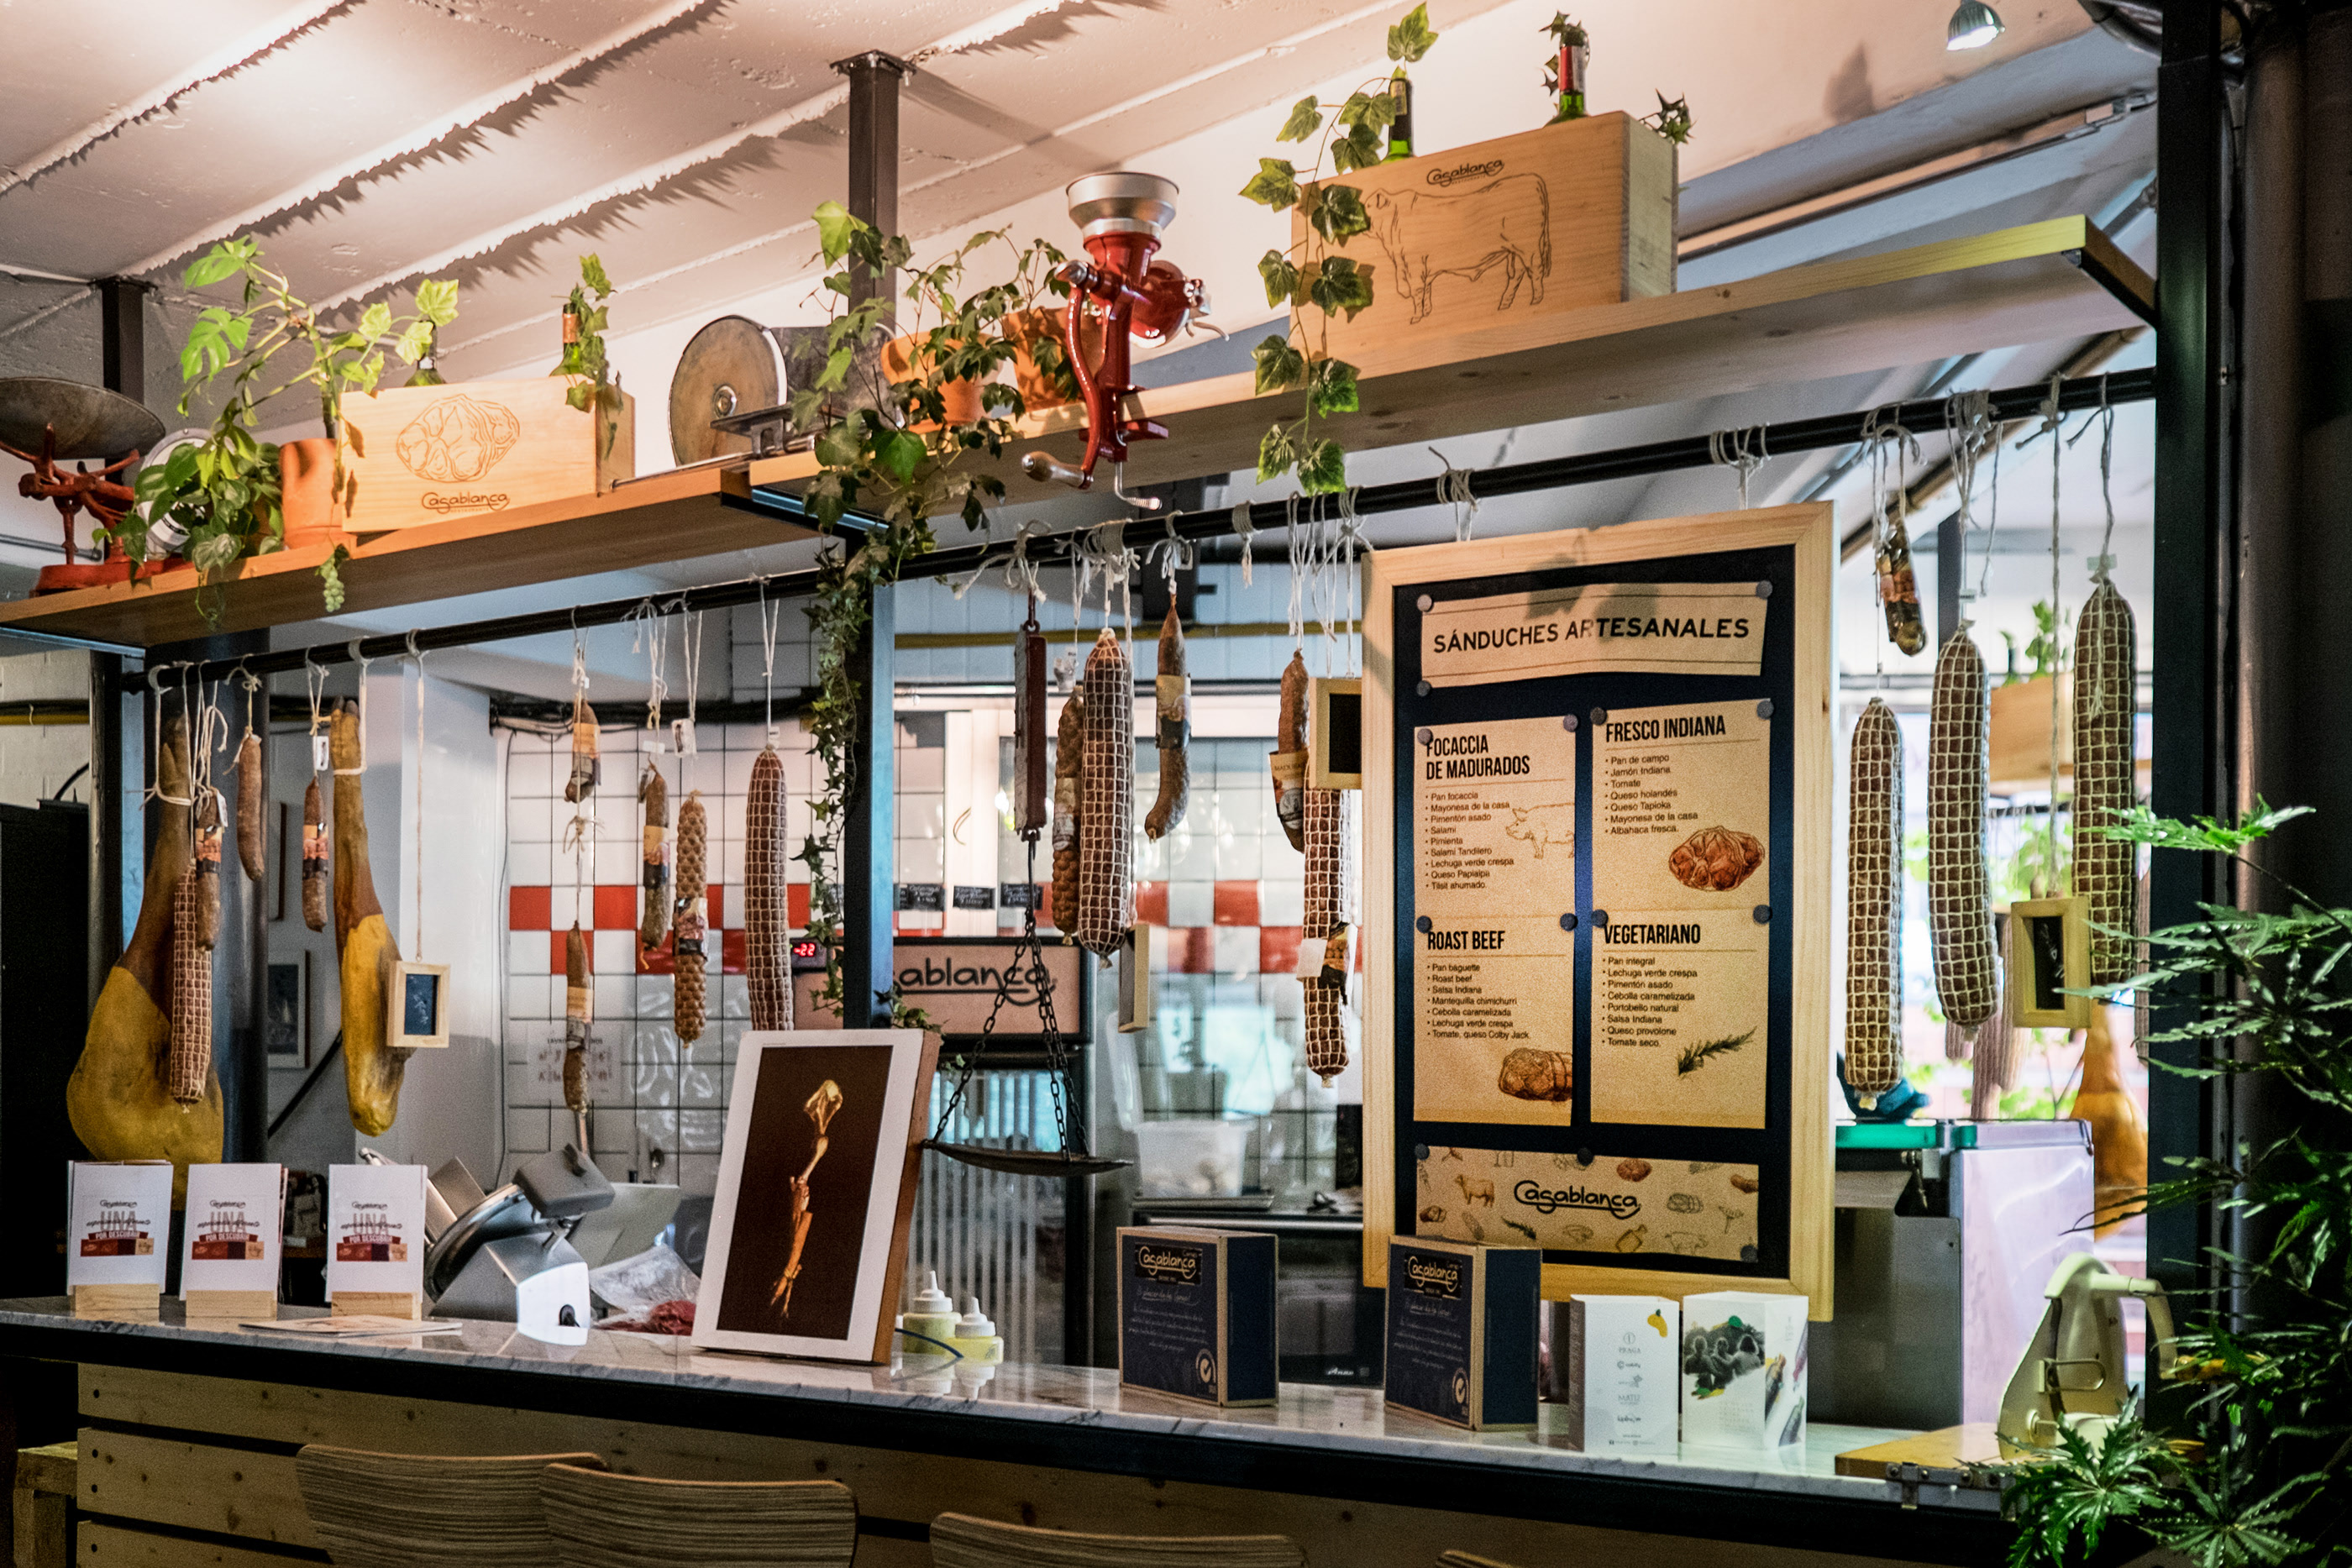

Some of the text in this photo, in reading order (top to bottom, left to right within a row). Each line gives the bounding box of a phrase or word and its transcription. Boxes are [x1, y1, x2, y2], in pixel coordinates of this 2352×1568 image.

[1426, 160, 1504, 187] Casablanca
[422, 491, 511, 515] Casablanca
[1433, 617, 1750, 653] SÁNDUCHES ARTESANALES
[1606, 716, 1725, 742] FRESCO INDIANA
[1427, 735, 1488, 757] FOCACCIA
[1641, 755, 1669, 764] campo
[1427, 755, 1530, 779] DE MADURADOS
[1611, 766, 1670, 777] Jamón Indiana
[1611, 779, 1641, 788] Tomate
[1431, 793, 1446, 801] Pan
[1641, 789, 1677, 798] holandés
[1431, 804, 1469, 813] Mayonesa
[1472, 802, 1481, 810] de
[1641, 802, 1671, 810] Tapioka
[1431, 814, 1467, 822] Pimentón
[1611, 815, 1652, 824] Mayonesa
[1655, 813, 1665, 821] de
[1611, 826, 1648, 834] Albahaca
[1431, 837, 1463, 846] Pimienta
[1431, 860, 1462, 868] Lechuga
[1488, 858, 1515, 867] crespa
[1431, 871, 1456, 879] Queso
[1604, 924, 1701, 944] VEGETARIANO
[1428, 931, 1505, 950] ROAST BEEF
[1626, 957, 1655, 966] integral
[1449, 964, 1480, 973] baguette
[1609, 968, 1642, 978] Lechuga
[1669, 970, 1697, 978] crespa
[893, 957, 1057, 1006] ablanca
[1432, 1008, 1460, 1016] Cebolla
[1608, 1004, 1679, 1012] Portobello natural
[1432, 1020, 1464, 1028] Lechuga
[1488, 1030, 1509, 1040] Colby
[1607, 1026, 1677, 1036] Queso provolone
[1514, 1180, 1641, 1220] Casablanca
[1138, 1246, 1197, 1279] Casablanca
[1408, 1256, 1458, 1293] Casablanca
